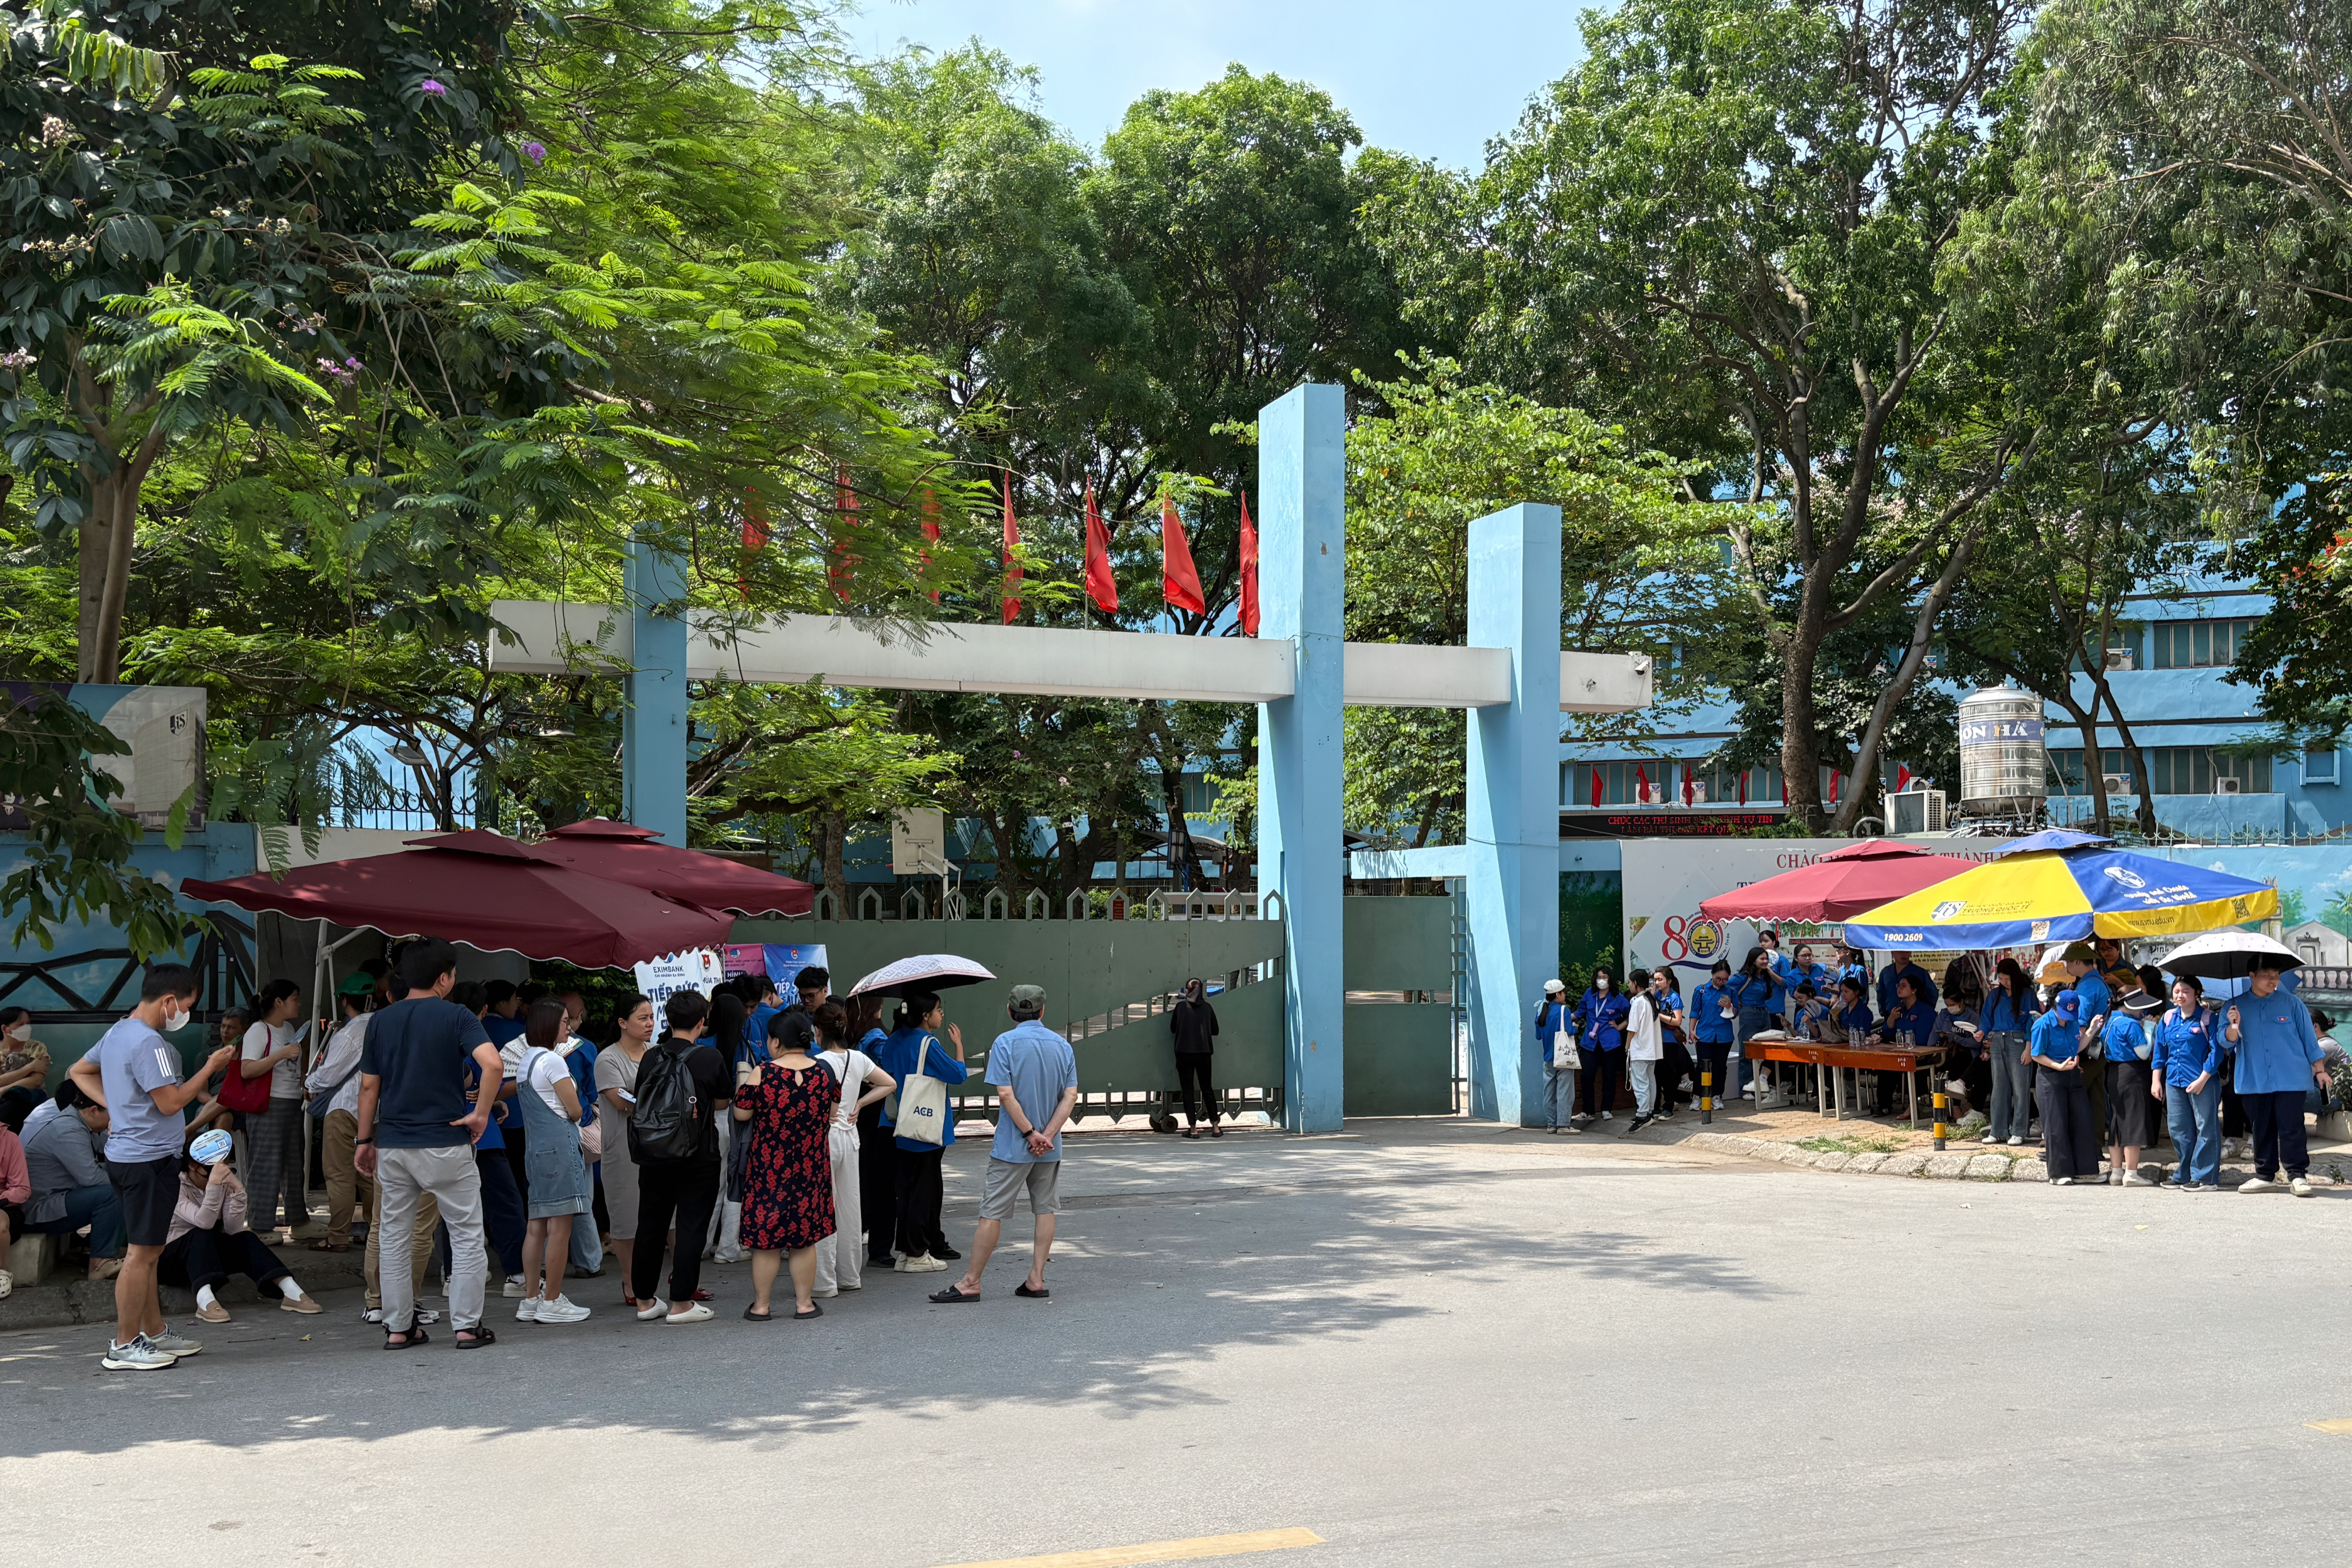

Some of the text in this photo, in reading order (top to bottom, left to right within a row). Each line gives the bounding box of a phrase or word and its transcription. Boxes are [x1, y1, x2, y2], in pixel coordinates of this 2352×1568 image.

[1757, 815, 1773, 823] TIN
[1884, 933, 1923, 942] 1900 2609
[647, 982, 673, 1002] TIẾP
[913, 1105, 933, 1117] ACB
